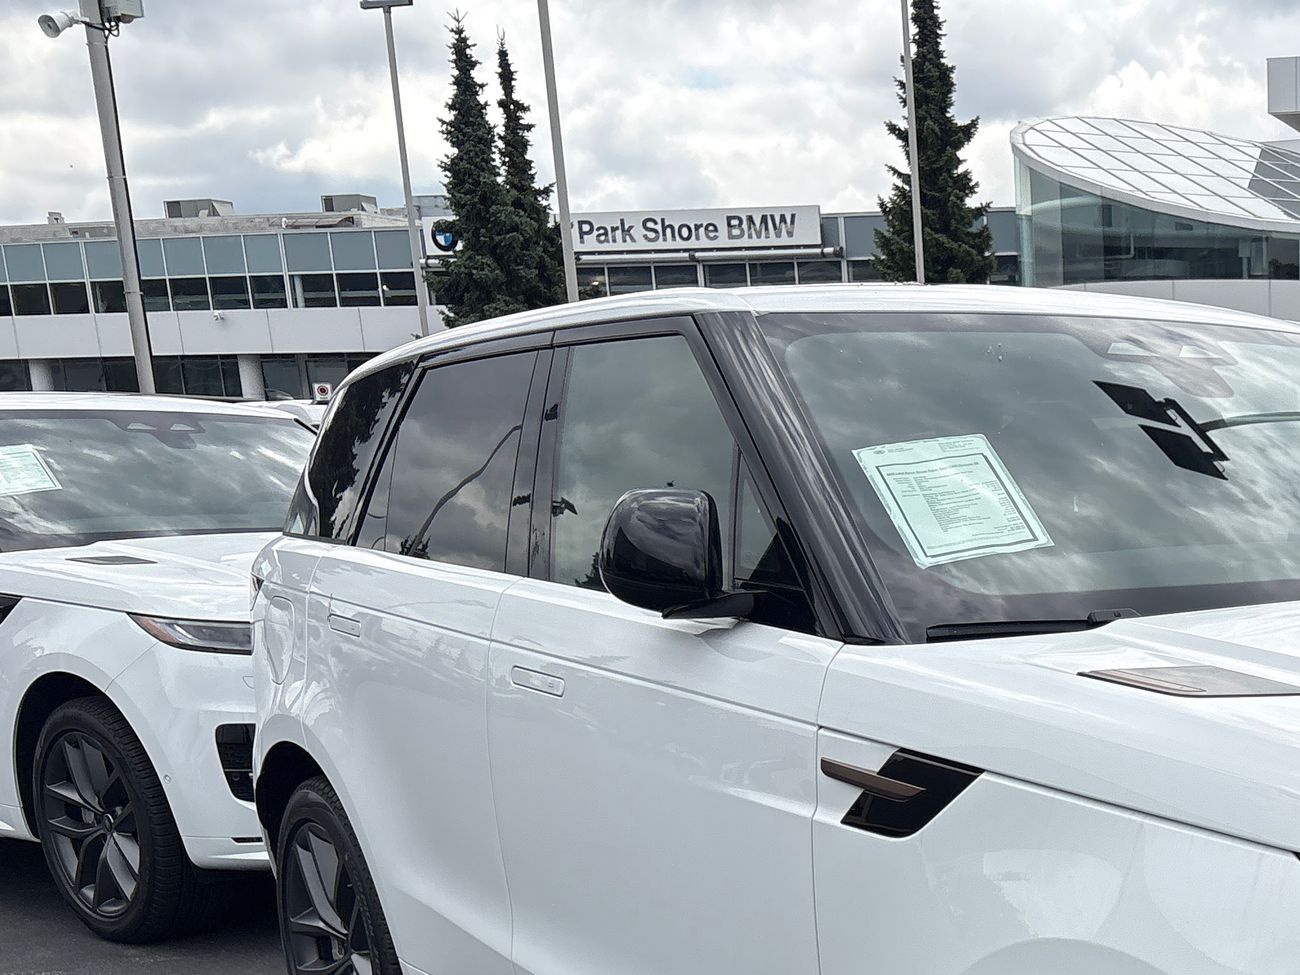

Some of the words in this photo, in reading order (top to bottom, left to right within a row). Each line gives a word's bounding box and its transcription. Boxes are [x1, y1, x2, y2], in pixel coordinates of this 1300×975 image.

[577, 218, 637, 245] Park
[641, 217, 720, 243] Shore
[725, 213, 797, 240] BMW
